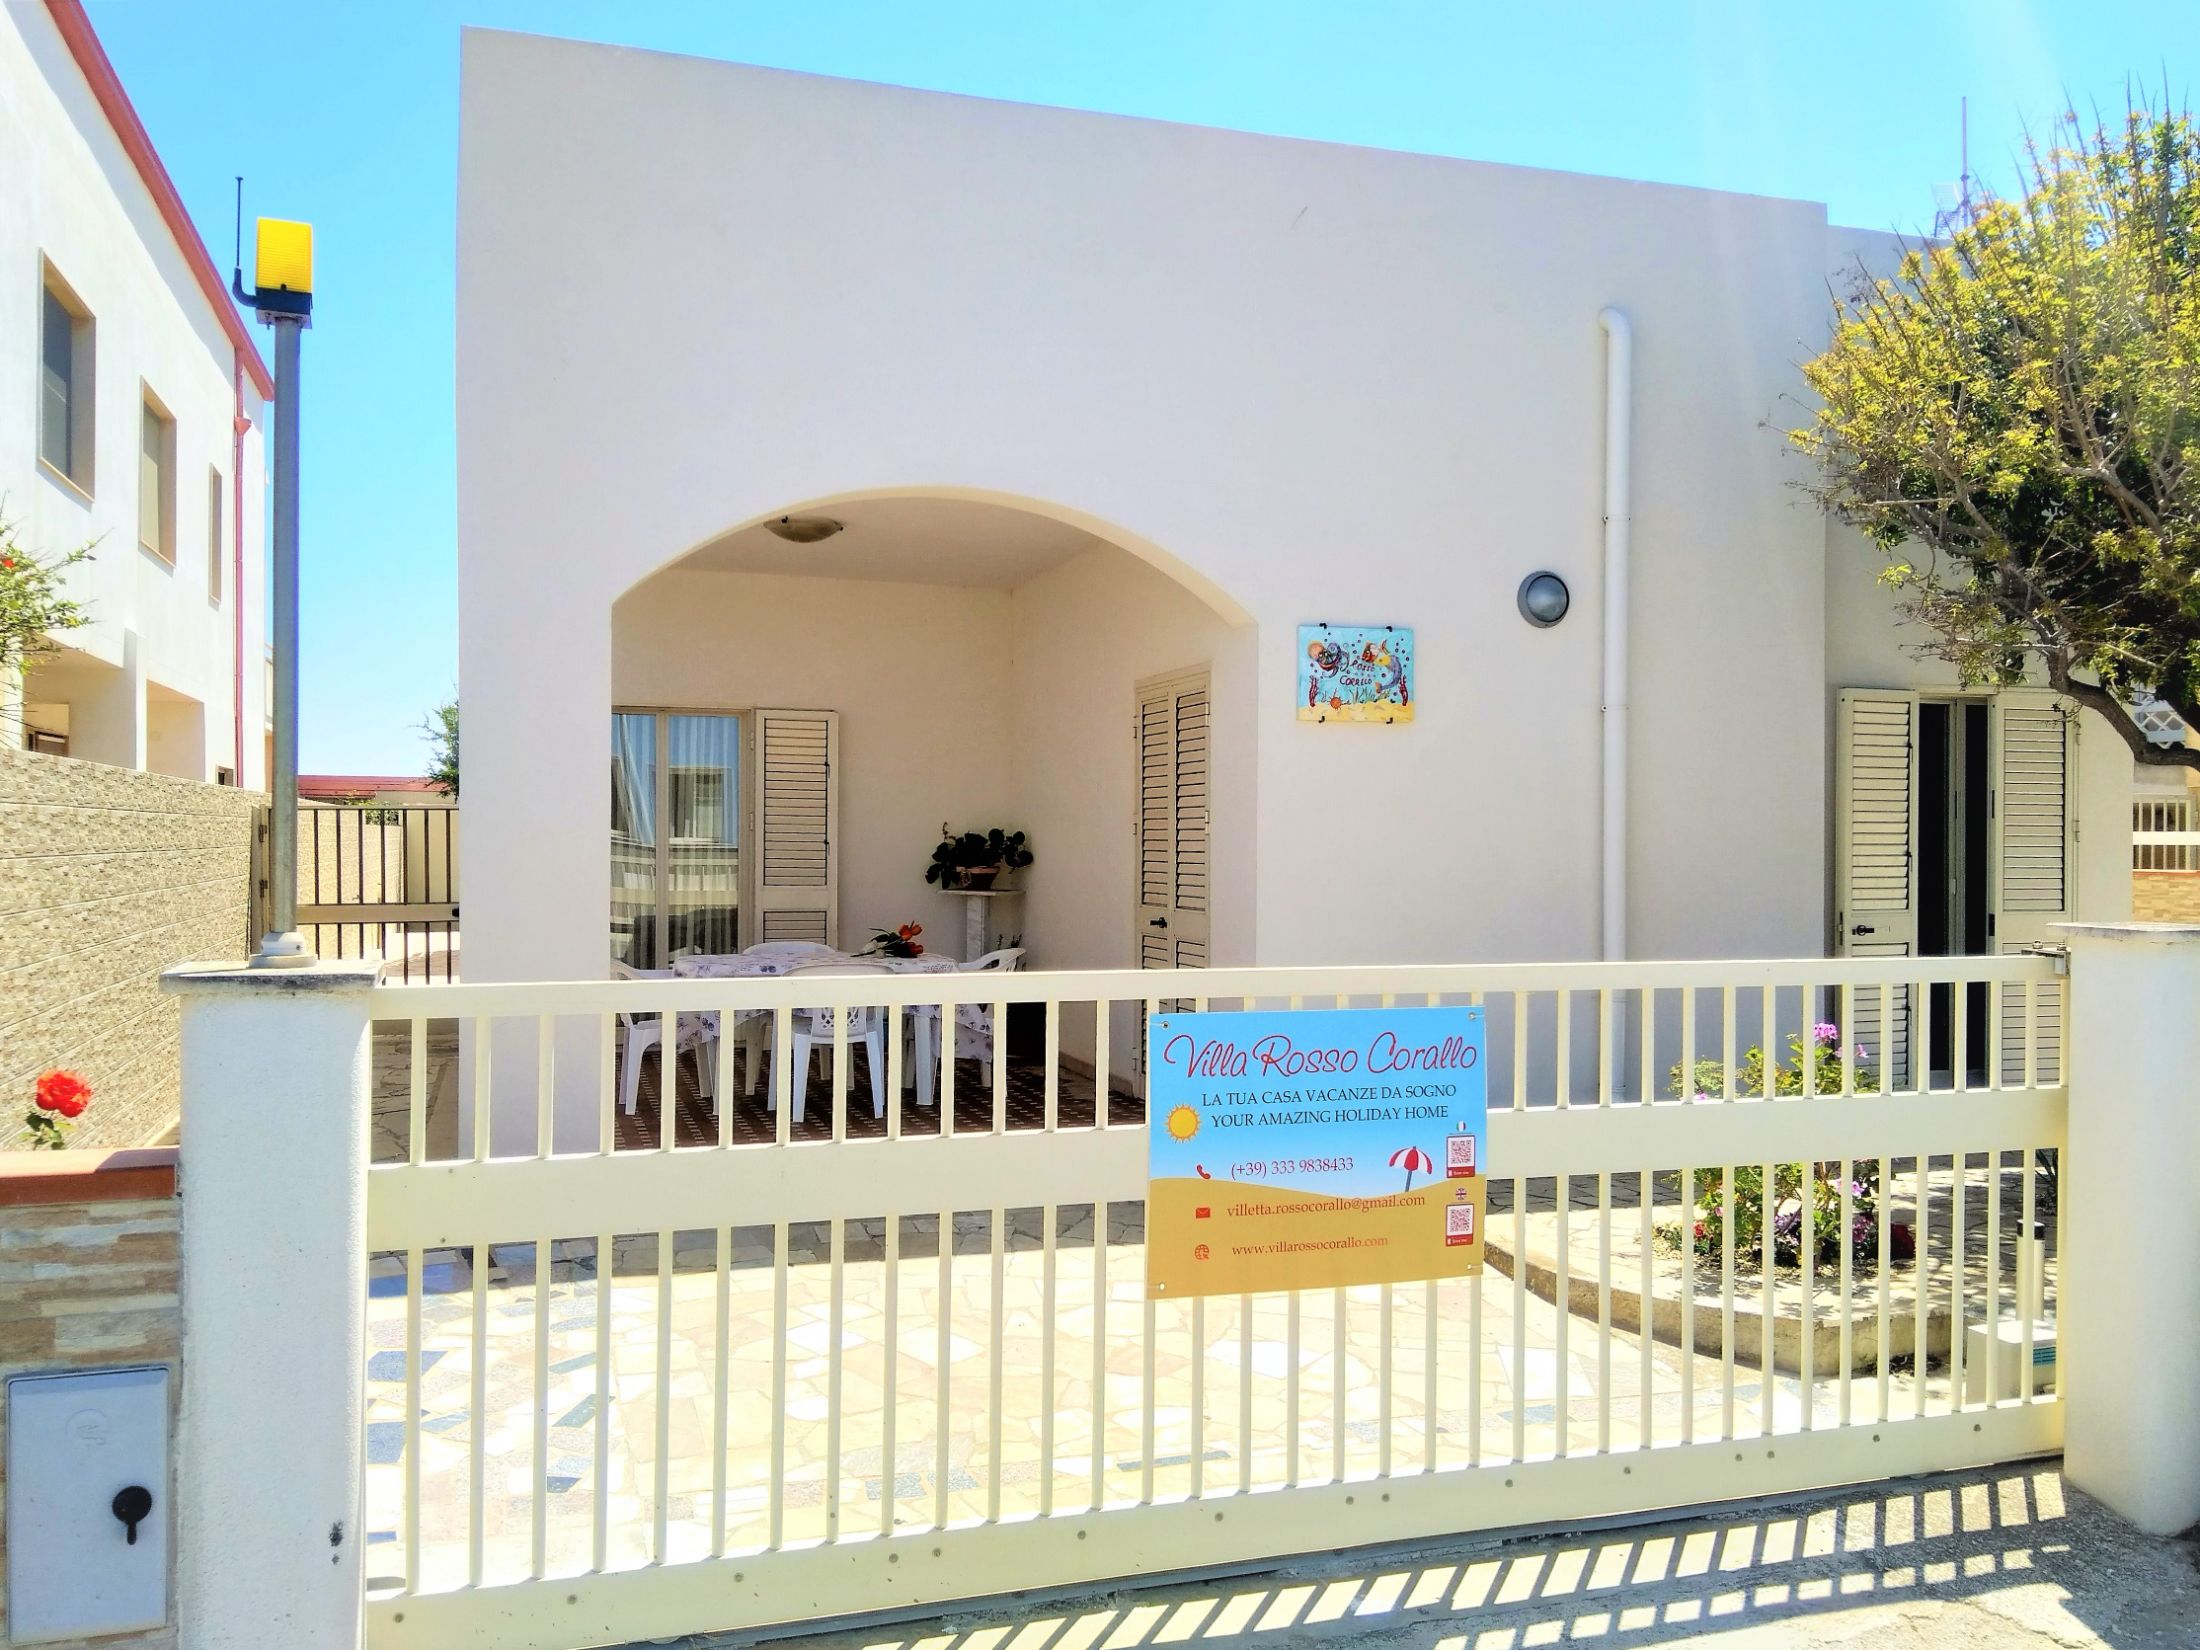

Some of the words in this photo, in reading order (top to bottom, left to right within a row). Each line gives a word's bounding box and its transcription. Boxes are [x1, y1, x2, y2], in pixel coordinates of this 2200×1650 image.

[1163, 1034, 1248, 1078] Villa
[1252, 1035, 1358, 1077] Rosso
[1367, 1031, 1477, 1073] Corallo
[1202, 1093, 1222, 1106] LA
[1226, 1092, 1257, 1105] TUA
[1262, 1090, 1302, 1103] CASA
[1305, 1087, 1377, 1102] VACANZE
[1381, 1087, 1402, 1099] DA
[1405, 1085, 1457, 1098] SOGNO
[1211, 1113, 1254, 1128] YOUR
[1258, 1110, 1331, 1126] AMAZING
[1335, 1107, 1403, 1123] HOLIDAY
[1405, 1105, 1449, 1119] HOME
[1231, 1161, 1267, 1179] (+39)
[1272, 1159, 1295, 1174] 333
[1299, 1158, 1354, 1173] 9838433
[1227, 1195, 1425, 1217] villetta.rossocorallo@gmail.com
[1232, 1236, 1388, 1256] www.villarossocorallo.com
